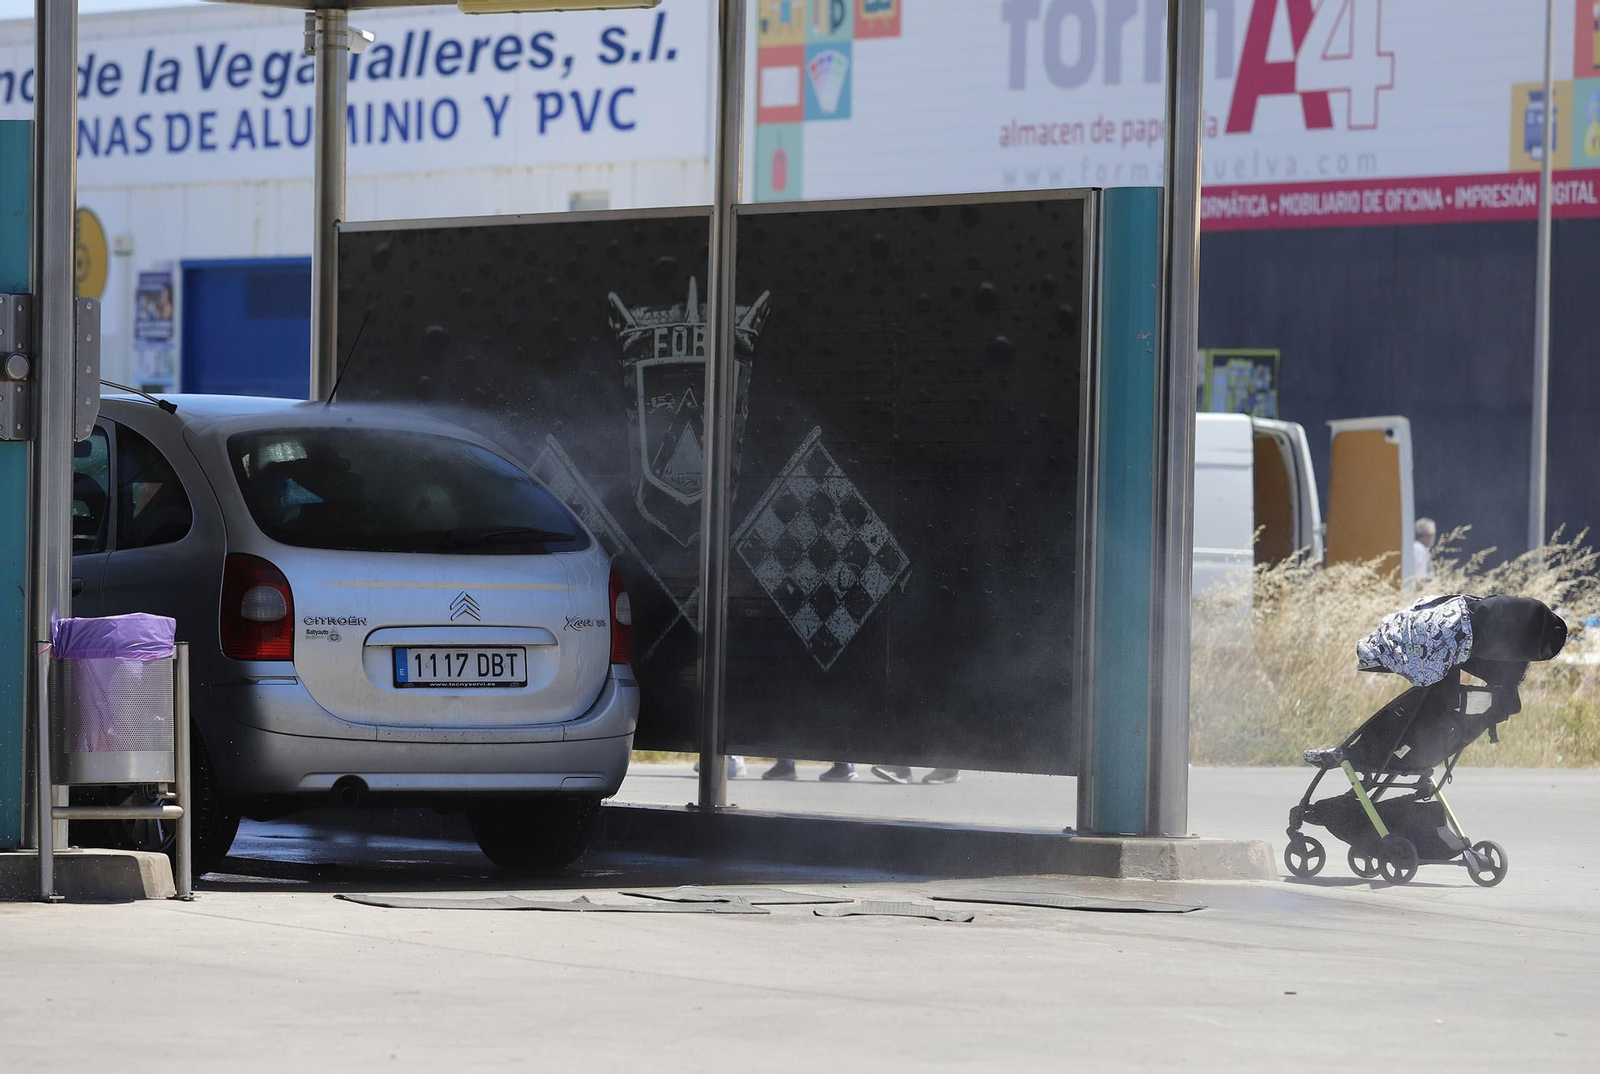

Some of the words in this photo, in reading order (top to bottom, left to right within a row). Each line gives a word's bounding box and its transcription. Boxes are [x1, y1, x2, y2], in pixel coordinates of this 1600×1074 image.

[77, 53, 122, 98] de
[139, 48, 182, 95] la
[194, 43, 315, 99] Vega
[598, 11, 677, 66] s.l.
[166, 111, 217, 153] DE
[484, 94, 510, 138] Y
[536, 87, 636, 135] PVC
[1000, 117, 1084, 148] almacen
[1090, 115, 1116, 144] de
[1201, 190, 1269, 219] ORMÁTICA
[1279, 190, 1360, 217] MOBILIARIO
[1362, 188, 1383, 213] DE
[1385, 186, 1444, 212] OFICINA
[1455, 177, 1537, 210] IMPRESIÓN
[1551, 180, 1597, 206] IGITAL
[303, 615, 367, 626] CITROËN
[414, 653, 469, 677] 1117
[477, 653, 518, 677] DBT
